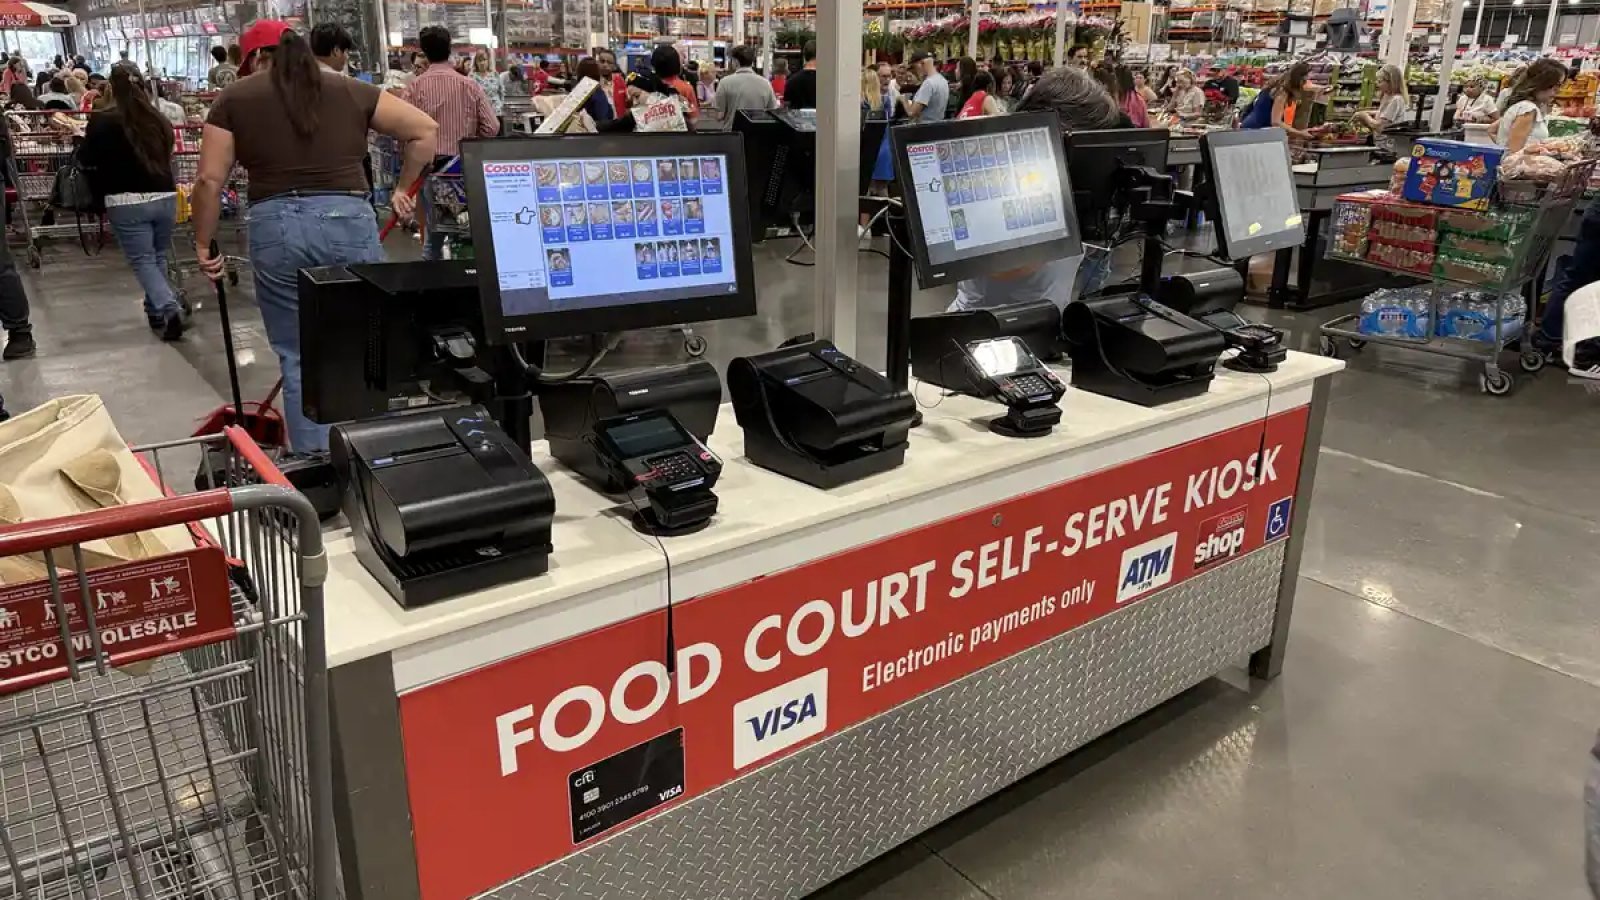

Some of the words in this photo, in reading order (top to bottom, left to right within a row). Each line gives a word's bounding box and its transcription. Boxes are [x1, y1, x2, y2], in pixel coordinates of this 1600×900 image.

[484, 163, 530, 173] COSTCO
[1195, 527, 1245, 564] shop
[1121, 544, 1174, 590] ATM
[496, 641, 722, 777] FOOD
[743, 559, 937, 673] COURT
[949, 482, 1172, 598] SELF-SERVE
[1183, 444, 1283, 513] KIOSK
[862, 632, 964, 692] Electronic
[970, 594, 1056, 652] payments
[1060, 578, 1096, 605] only
[744, 692, 817, 742] VISA
[574, 770, 594, 787] citi
[659, 784, 682, 801] VISA
[615, 792, 632, 805] 2345
